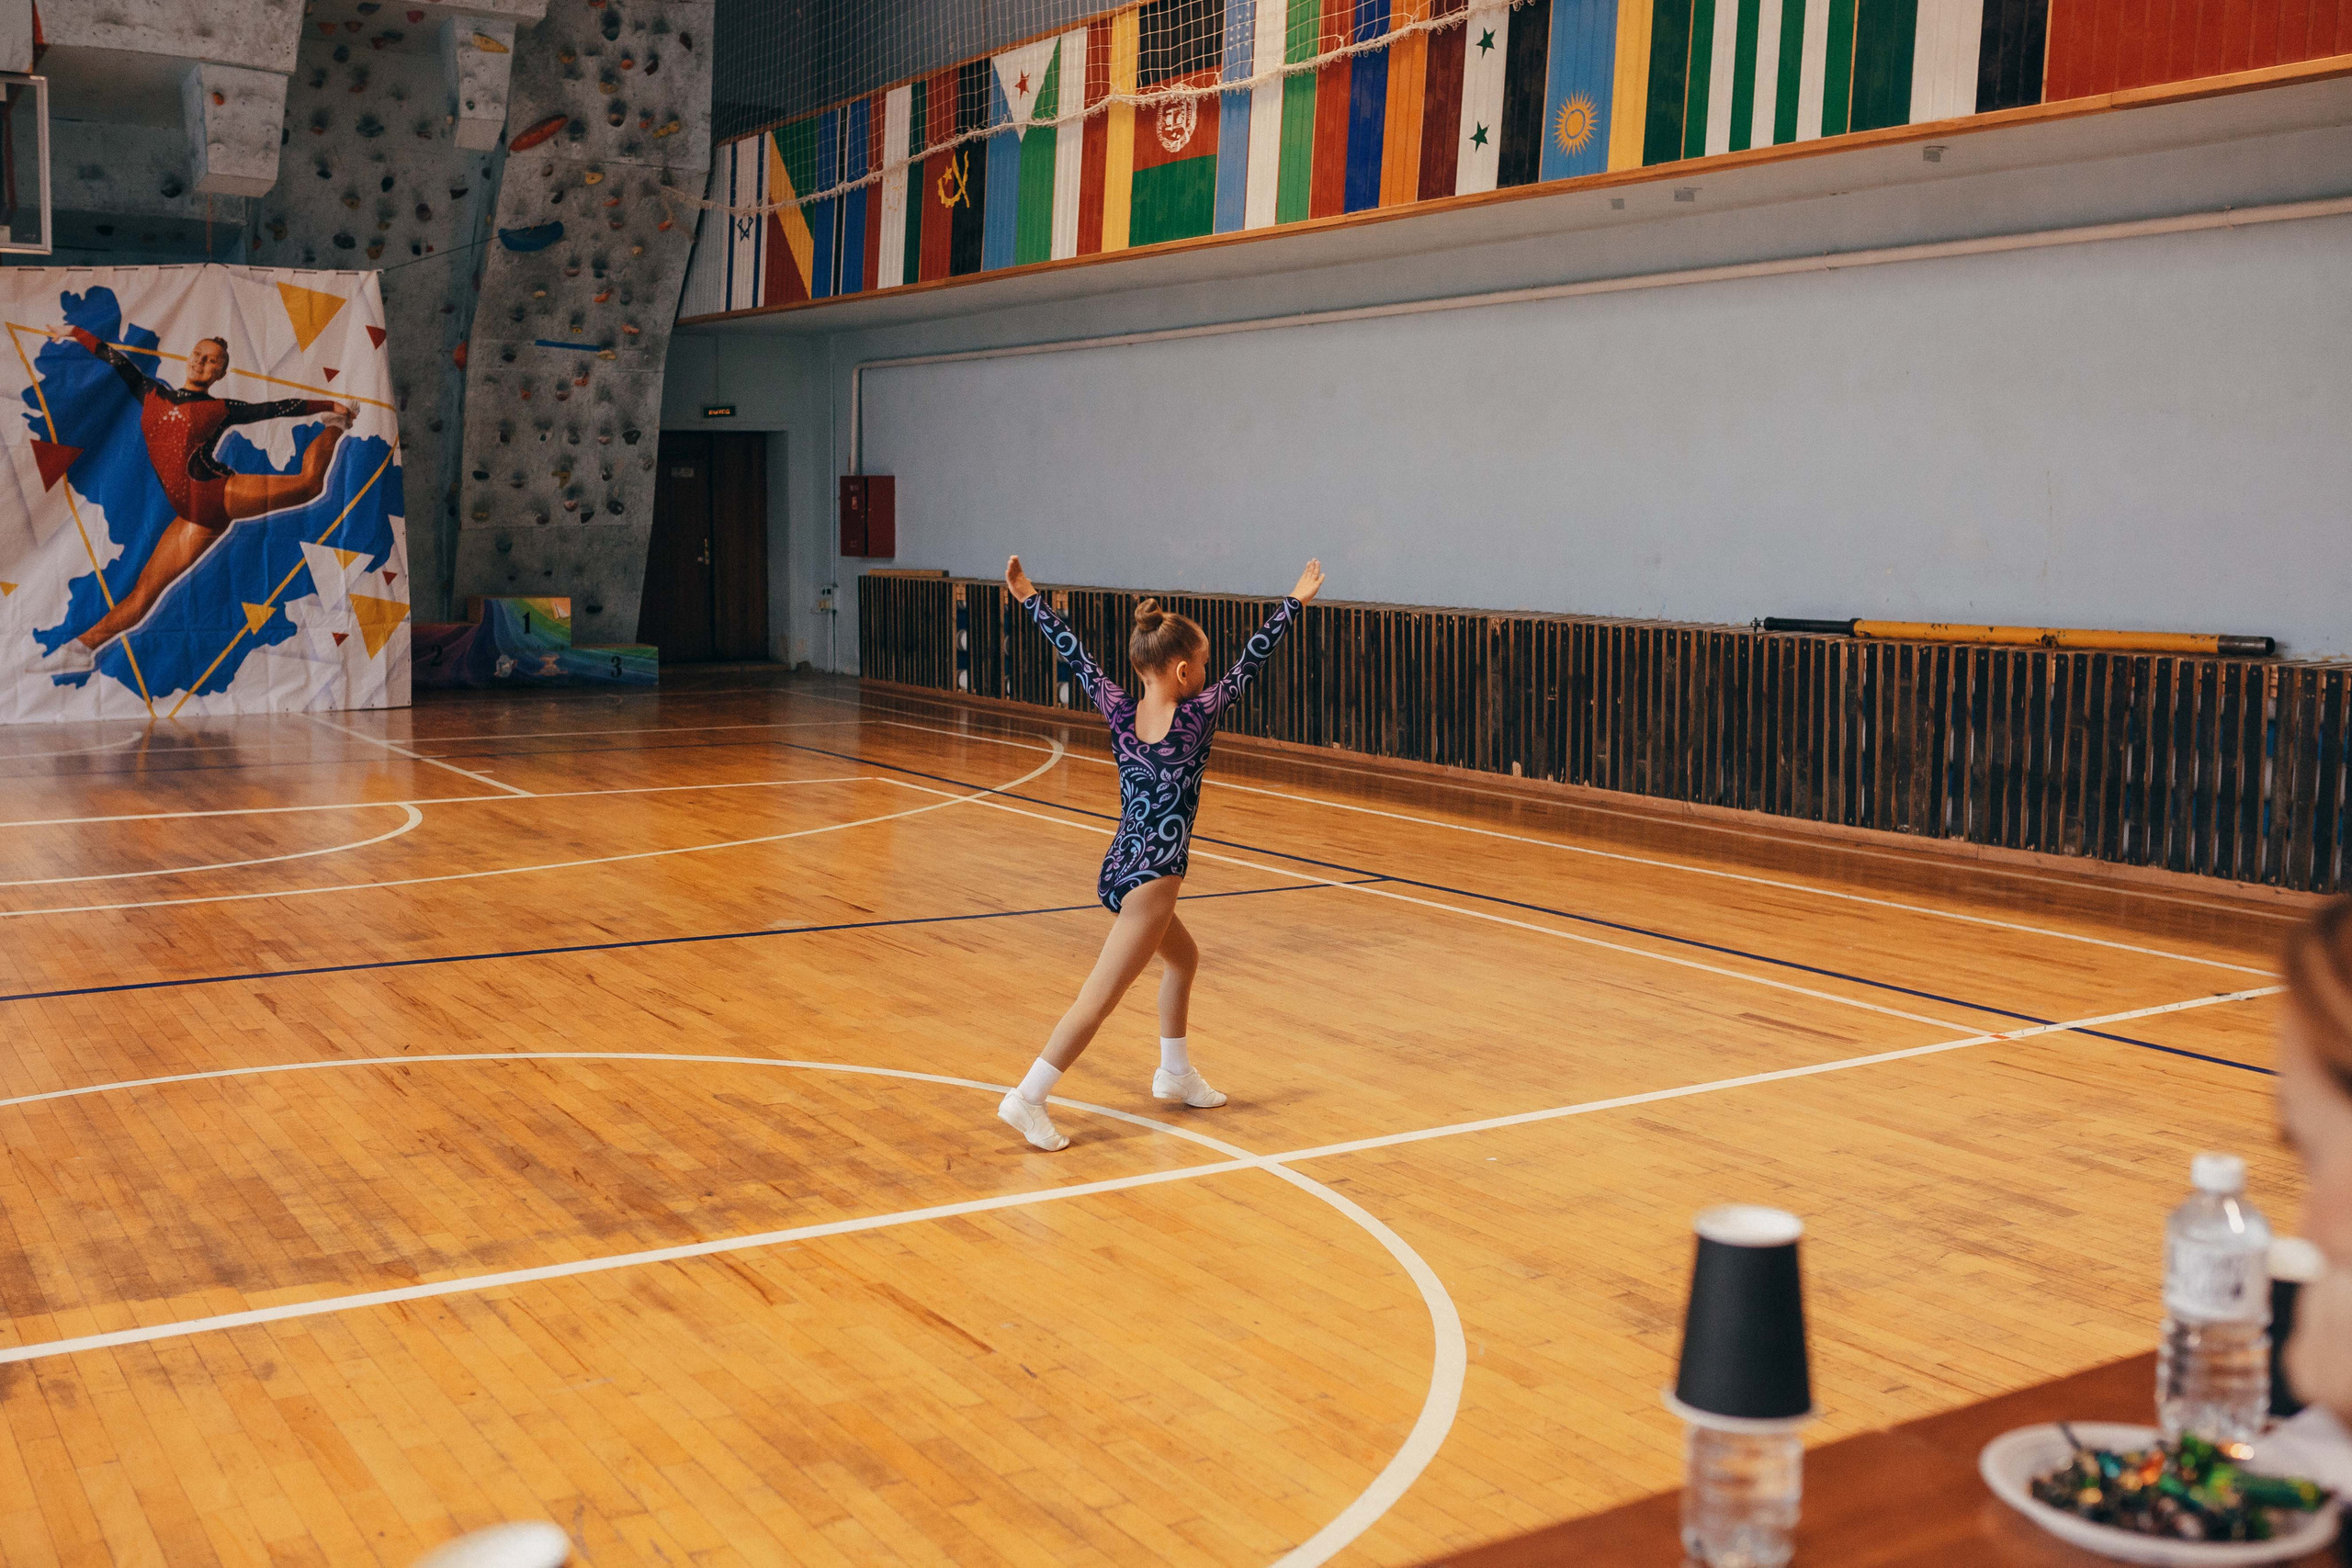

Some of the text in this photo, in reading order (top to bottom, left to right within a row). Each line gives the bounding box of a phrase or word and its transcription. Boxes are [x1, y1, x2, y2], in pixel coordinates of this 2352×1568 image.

[522, 611, 531, 634] 1
[430, 645, 443, 667] 2
[610, 656, 622, 678] 3
